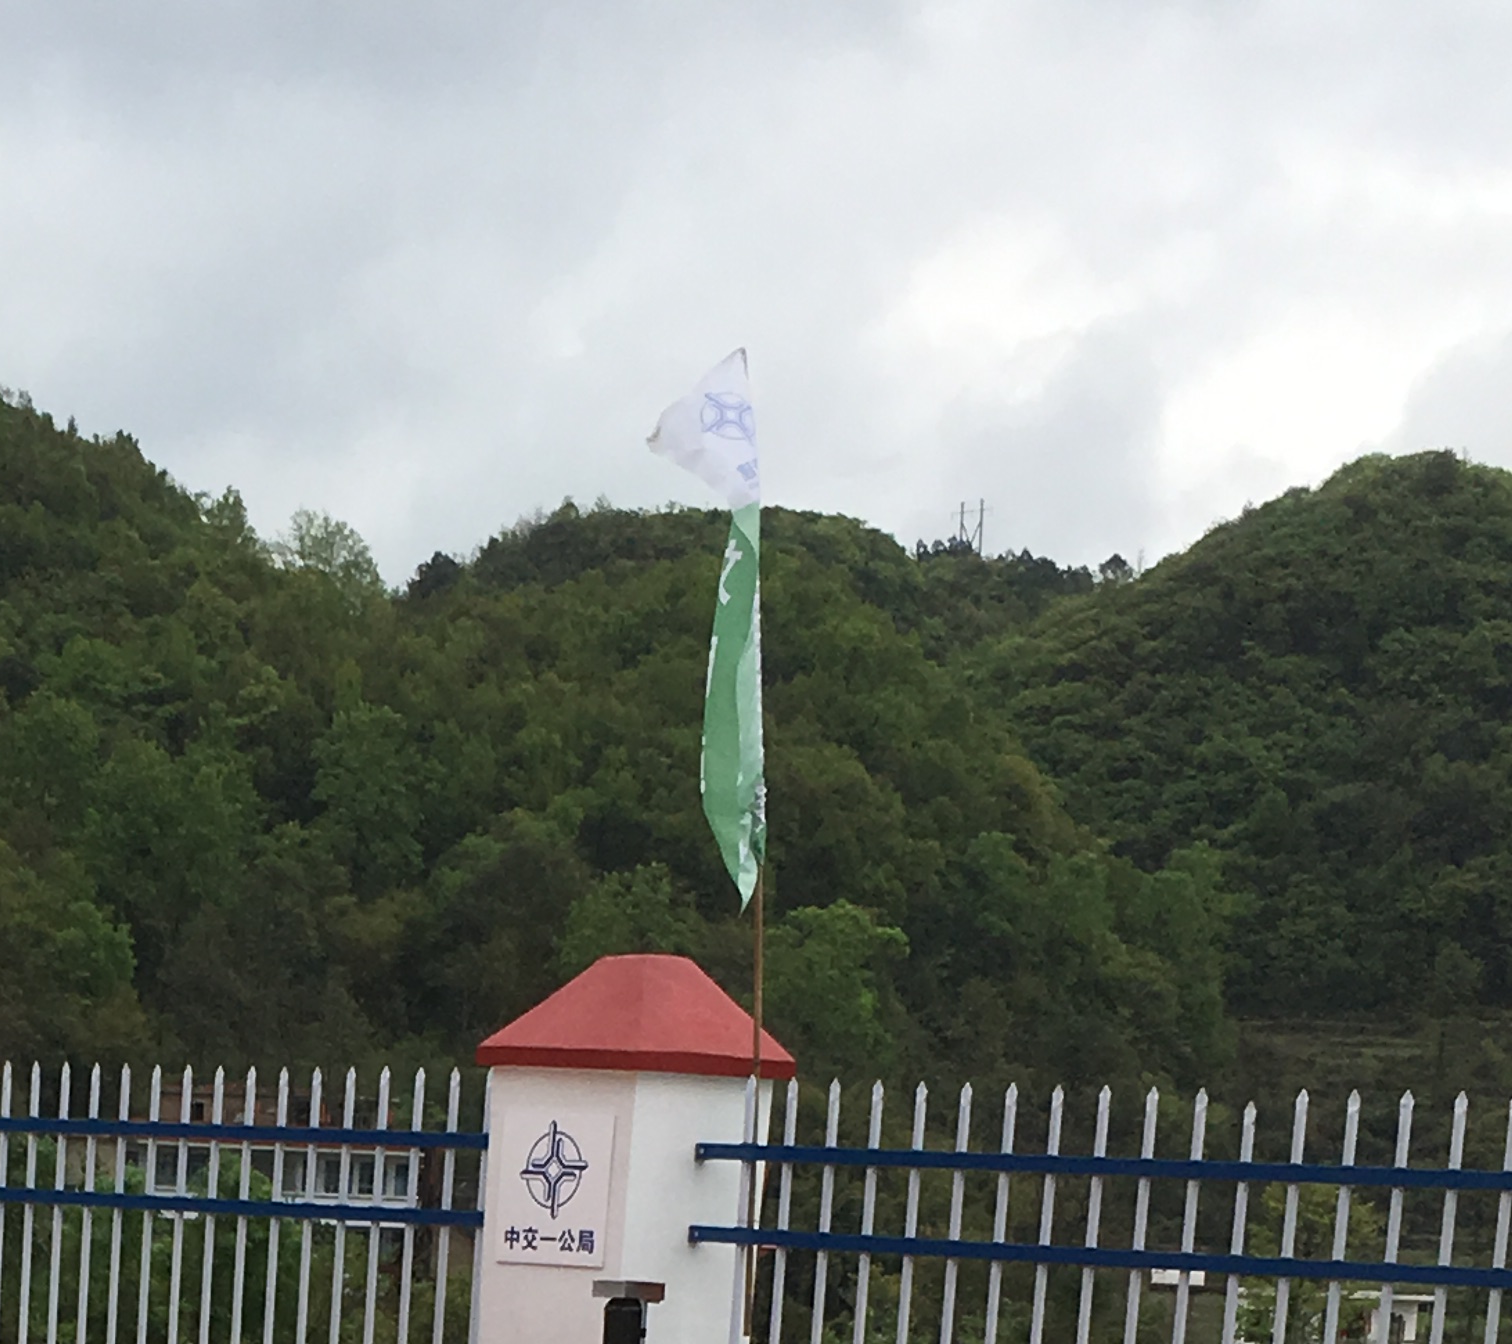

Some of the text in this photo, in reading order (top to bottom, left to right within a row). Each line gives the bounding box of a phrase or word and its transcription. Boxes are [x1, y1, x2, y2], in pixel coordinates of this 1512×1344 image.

[504, 1225, 595, 1254] 中交一公局
